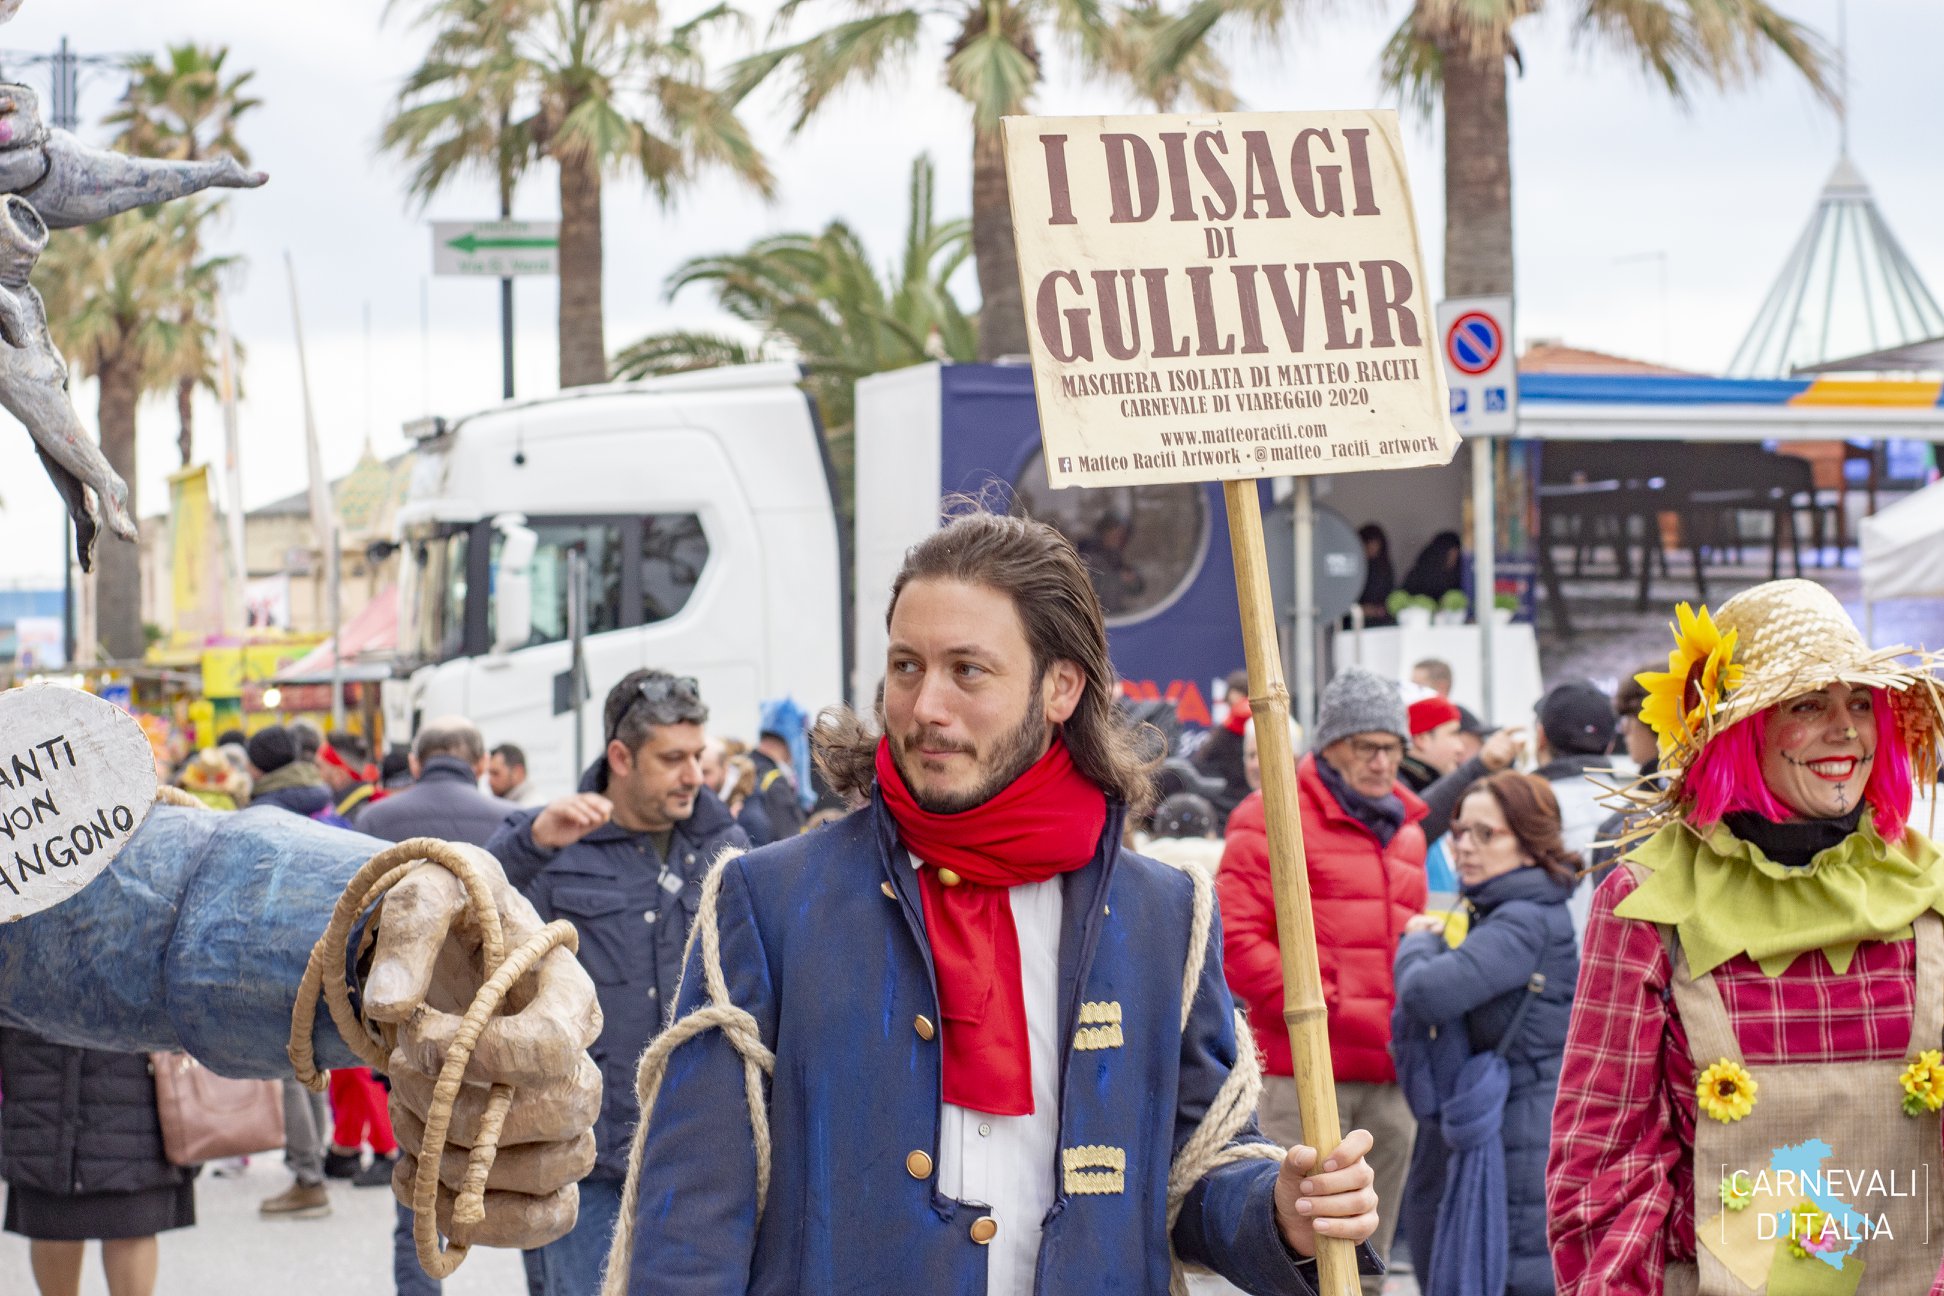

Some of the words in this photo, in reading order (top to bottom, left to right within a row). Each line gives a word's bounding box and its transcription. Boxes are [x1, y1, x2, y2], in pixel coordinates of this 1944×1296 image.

[1039, 134, 1078, 225] I
[1100, 128, 1381, 224] DISAGI
[1204, 227, 1238, 259] DI
[1036, 260, 1423, 363] GULLIVER
[1061, 371, 1163, 398] MASCHERA
[1167, 367, 1245, 392] ISOLATA
[1249, 366, 1272, 388] DI
[1277, 362, 1350, 387] MATTEO
[1356, 358, 1420, 383] RACITI
[1120, 395, 1208, 418] CARNEVALE
[1213, 394, 1232, 413] DI
[1236, 389, 1323, 412] VIAREGGIO
[1328, 387, 1369, 407] 2020
[1160, 423, 1328, 447] www.matteoraciti.com
[1078, 454, 1129, 473] Matteo
[1132, 450, 1177, 470] Raciti
[1182, 447, 1241, 467] Artwork
